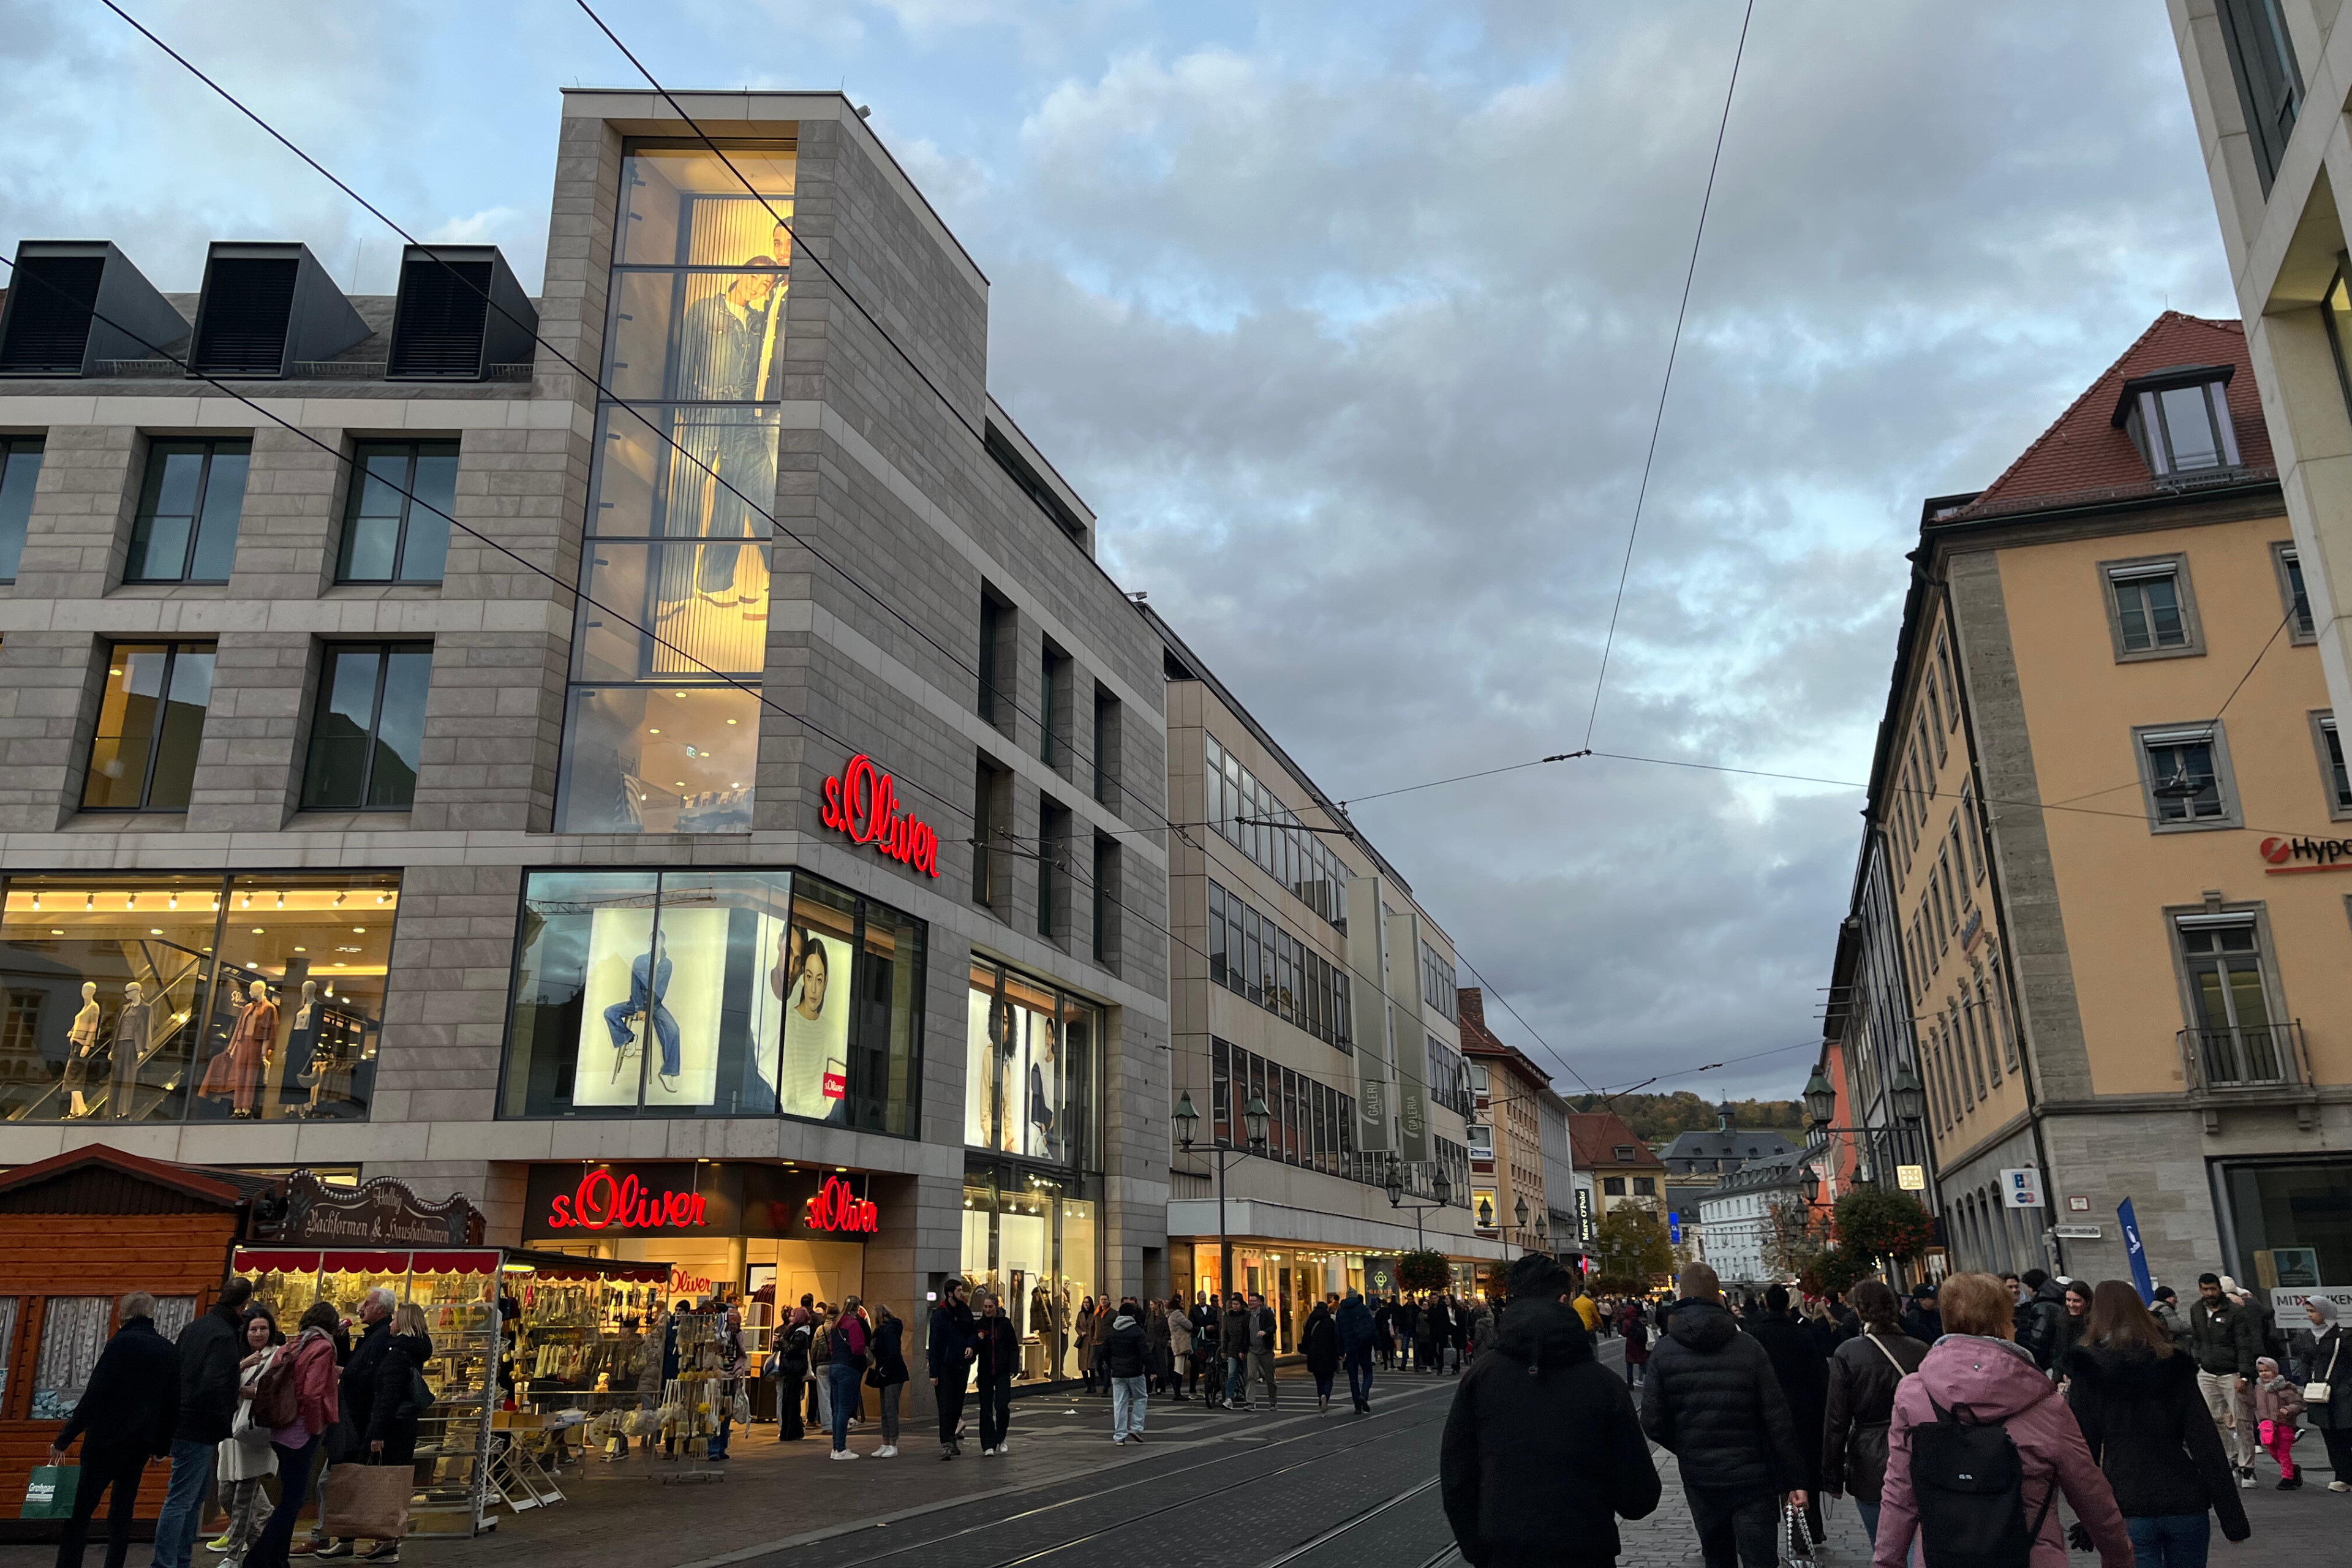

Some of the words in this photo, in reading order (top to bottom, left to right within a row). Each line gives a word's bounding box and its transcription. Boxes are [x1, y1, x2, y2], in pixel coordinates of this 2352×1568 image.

[821, 754, 940, 878] s.Oliver
[824, 1079, 845, 1092] s.Oliver
[1406, 1095, 1419, 1131] GALERIA
[372, 1186, 403, 1215] Halbig
[549, 1170, 710, 1229] s.Oliver
[807, 1176, 878, 1232] s.Oliver
[304, 1209, 368, 1239] Backformen
[369, 1216, 382, 1242] &
